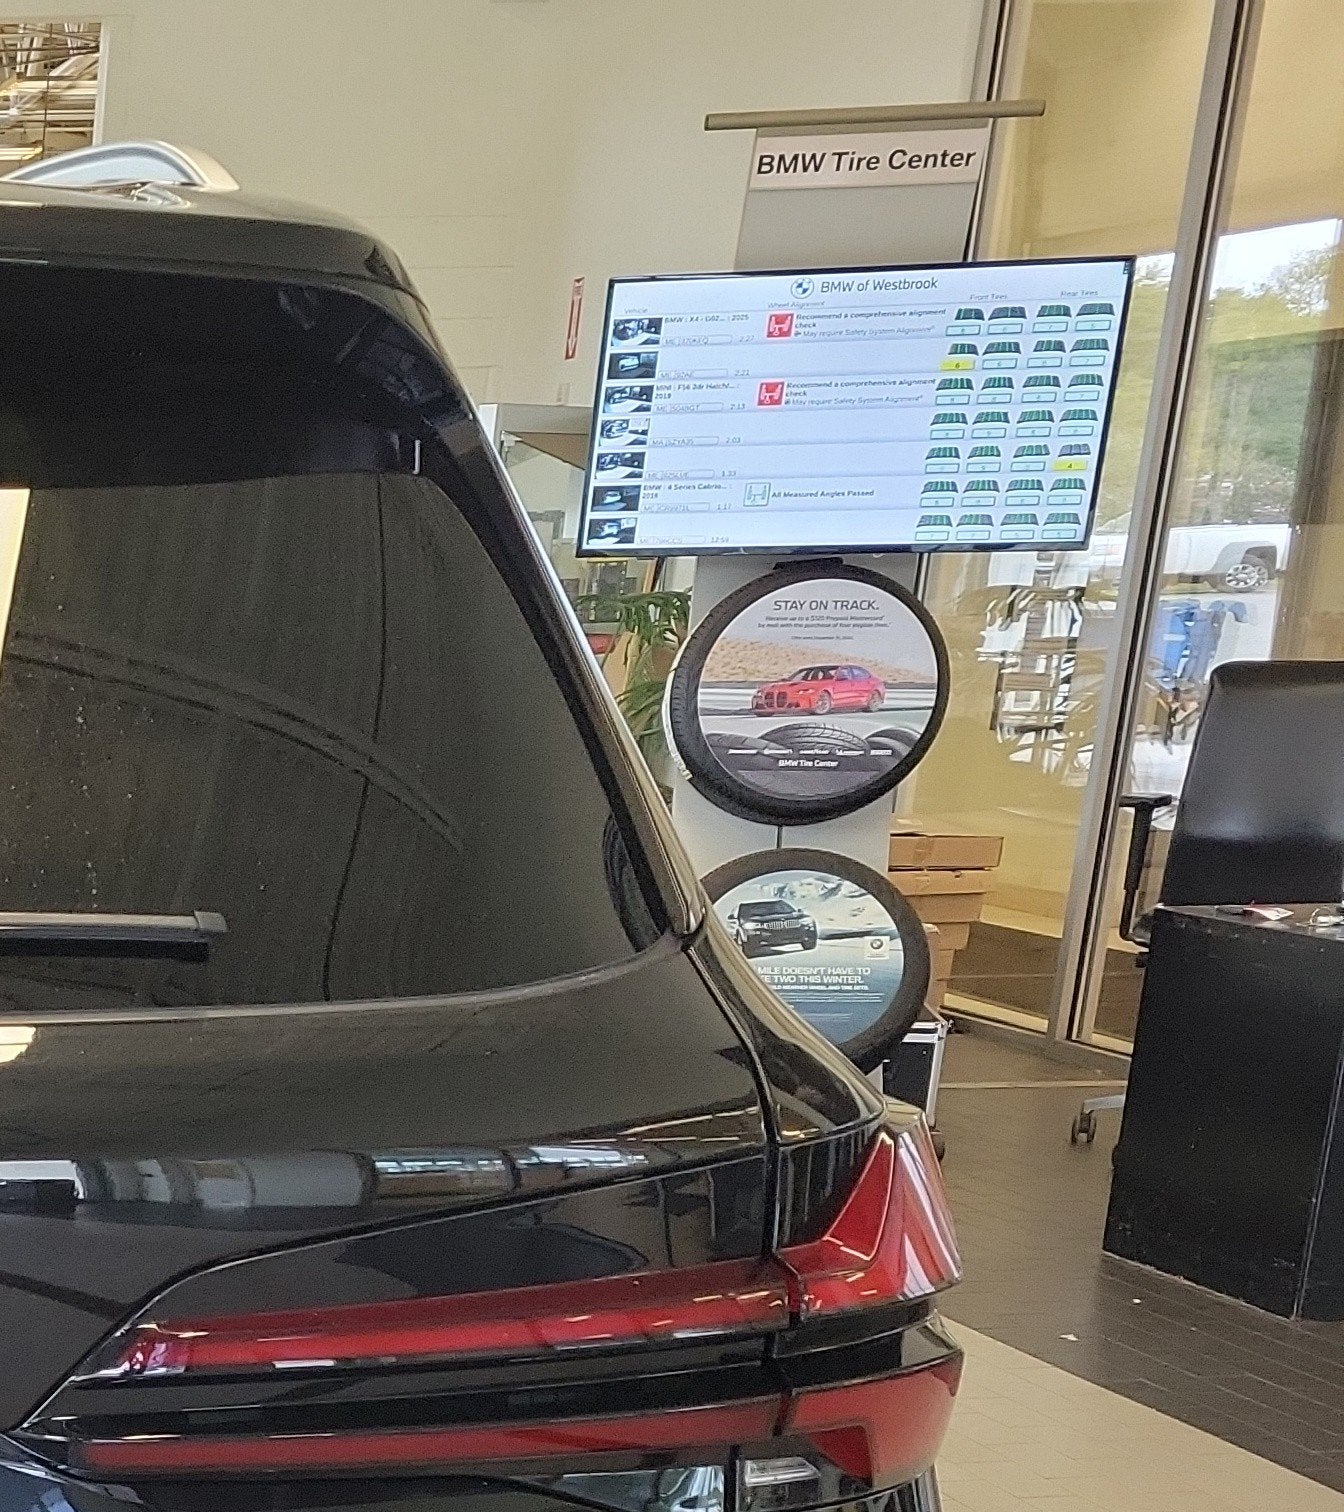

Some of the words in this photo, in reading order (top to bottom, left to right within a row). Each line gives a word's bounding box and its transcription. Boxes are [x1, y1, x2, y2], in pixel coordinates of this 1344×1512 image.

[756, 152, 827, 175] BMW
[831, 150, 880, 172] Tire
[887, 149, 976, 170] Center
[820, 281, 855, 293] BMW
[857, 279, 871, 292] of
[873, 277, 939, 291] Westbrook
[796, 313, 843, 321] Recommend
[850, 310, 908, 319] comprehensive
[908, 308, 947, 317] alignment
[794, 321, 817, 329] check
[803, 330, 818, 338] May
[819, 329, 844, 338] require
[840, 379, 897, 388] comprehensive
[898, 378, 936, 386] alignment
[783, 490, 819, 498] Measured
[820, 490, 845, 499] Angles
[847, 489, 874, 497] Passed
[773, 600, 807, 611] STAY
[809, 600, 828, 611] ON
[832, 600, 880, 611] TRACK.
[778, 759, 799, 767] BMW
[799, 759, 813, 767] Tire
[814, 759, 839, 768] Center
[758, 966, 781, 975] MILE
[782, 966, 826, 975] DOESN'T
[827, 966, 854, 975] HAVE
[857, 966, 871, 976] TO
[773, 975, 797, 983] TWO
[799, 975, 822, 983] THIS
[822, 975, 864, 983] WINTER.
